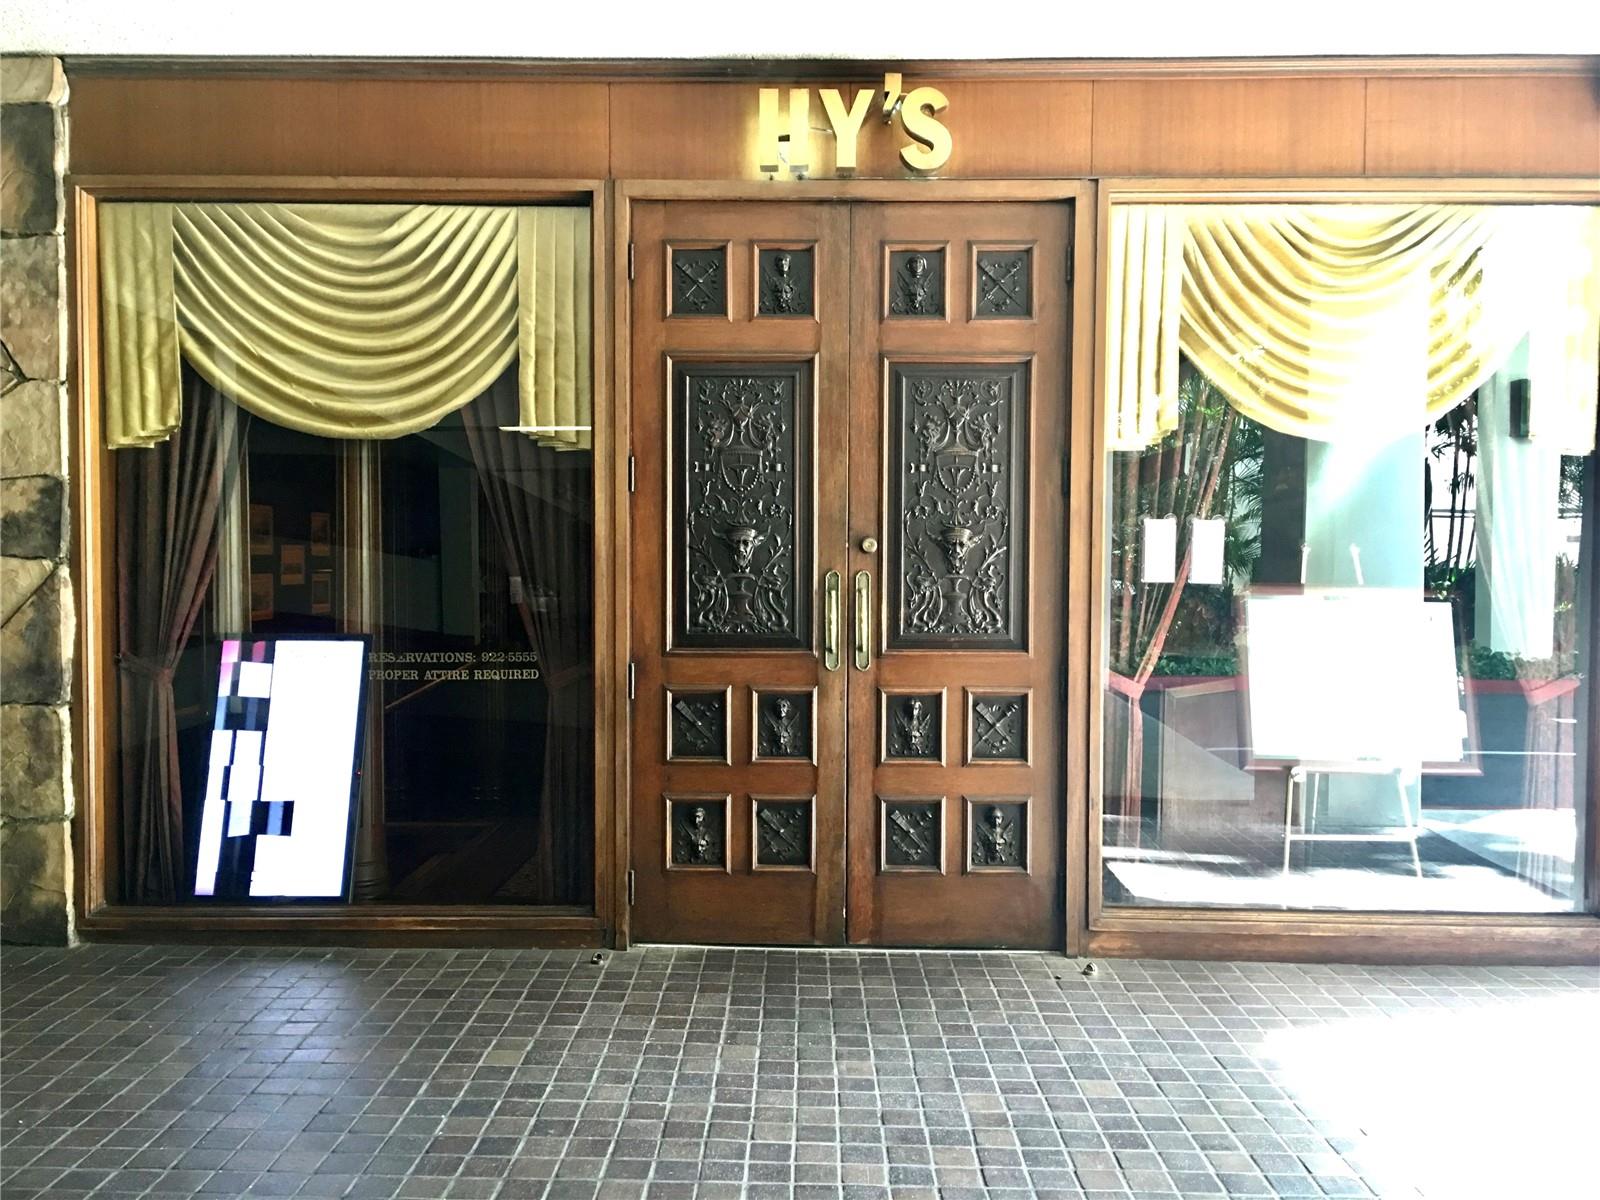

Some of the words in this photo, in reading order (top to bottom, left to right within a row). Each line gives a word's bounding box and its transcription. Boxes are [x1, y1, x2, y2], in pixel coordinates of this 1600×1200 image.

[759, 73, 952, 173] HY'S
[368, 670, 419, 681] PROPER
[424, 669, 470, 681] ATTIRE
[474, 669, 540, 681] REQUIRED
